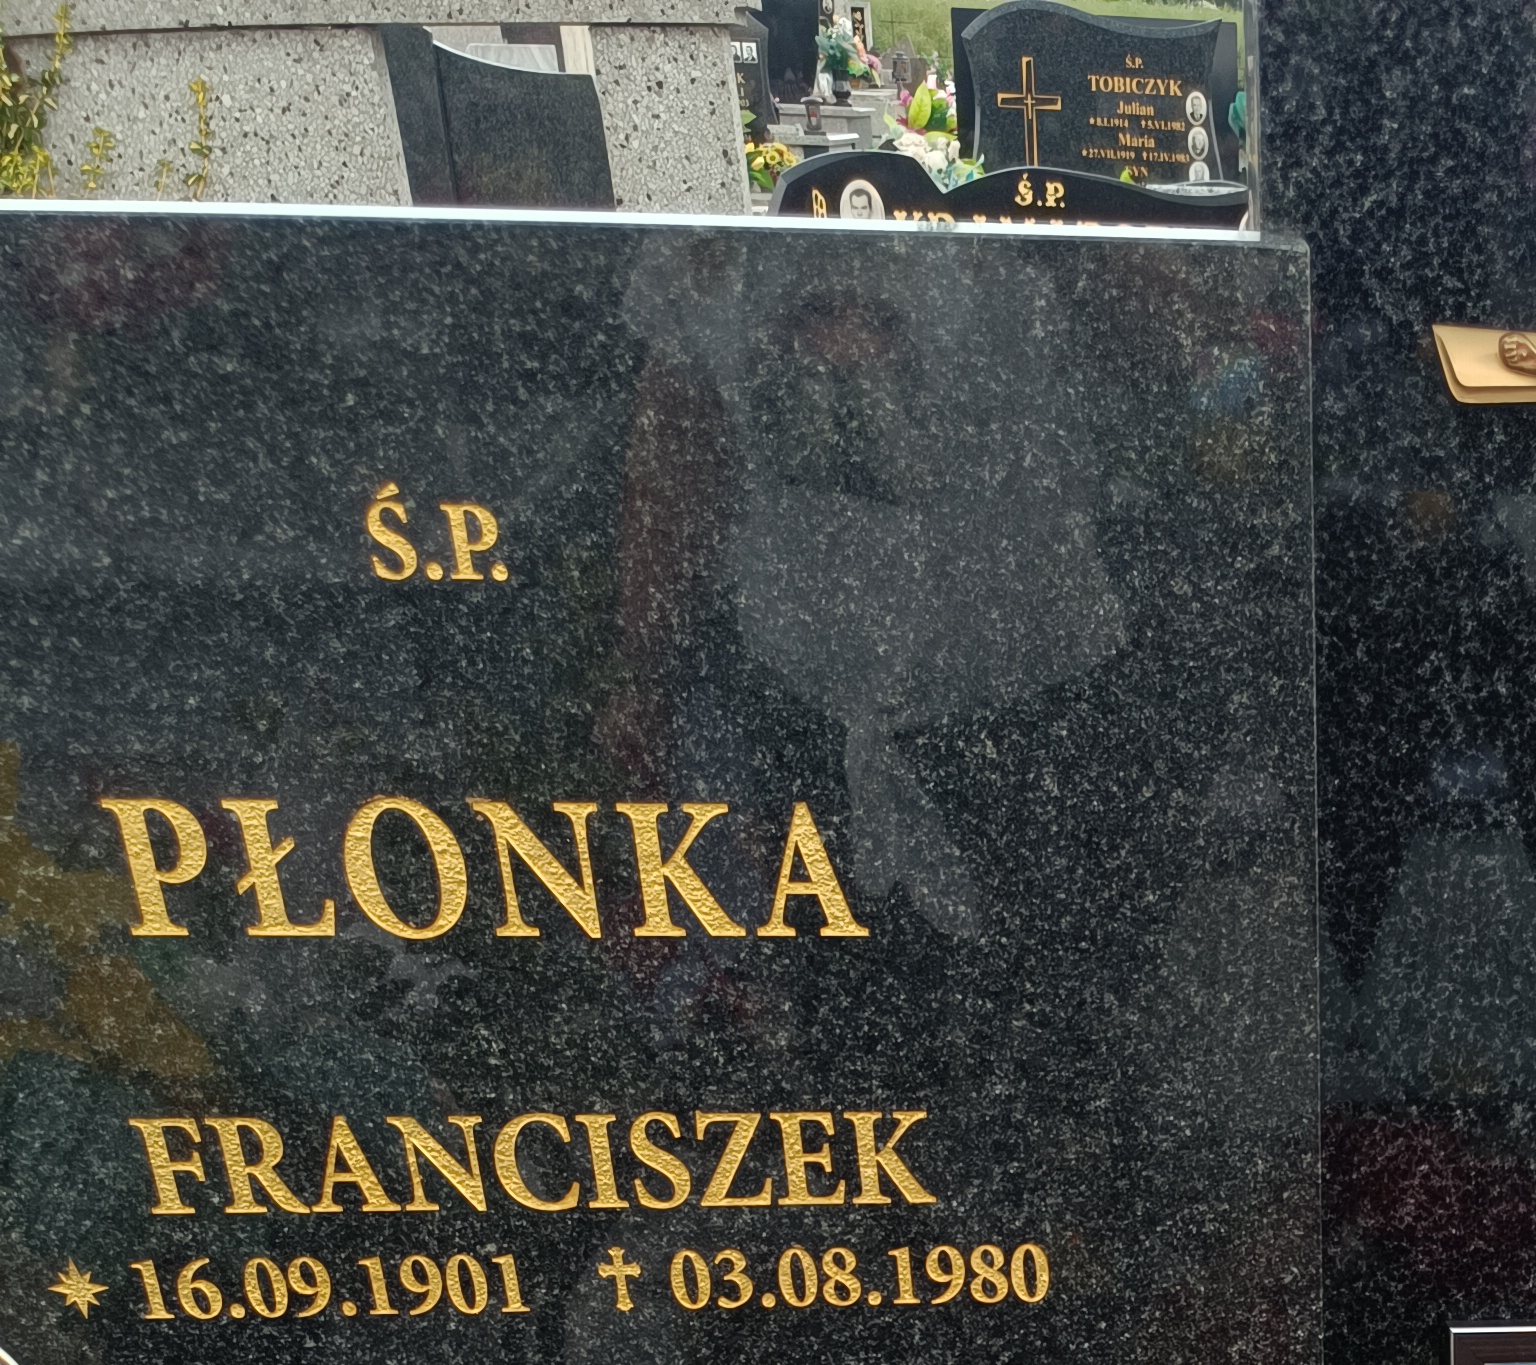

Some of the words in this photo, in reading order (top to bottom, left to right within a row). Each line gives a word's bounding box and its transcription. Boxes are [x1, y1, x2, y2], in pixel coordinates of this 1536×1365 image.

[1087, 74, 1183, 97] TOBICZYK
[1116, 101, 1155, 116] Julian
[1118, 132, 1156, 148] Maria
[1014, 172, 1066, 208] Ś.P.
[364, 481, 510, 582] Ś.P.
[98, 794, 871, 940] PŁONKA
[128, 1109, 938, 1215] FRANCISZEK
[130, 1252, 531, 1320] 16.09.1901
[669, 1241, 1050, 1310] 03.08.1980
